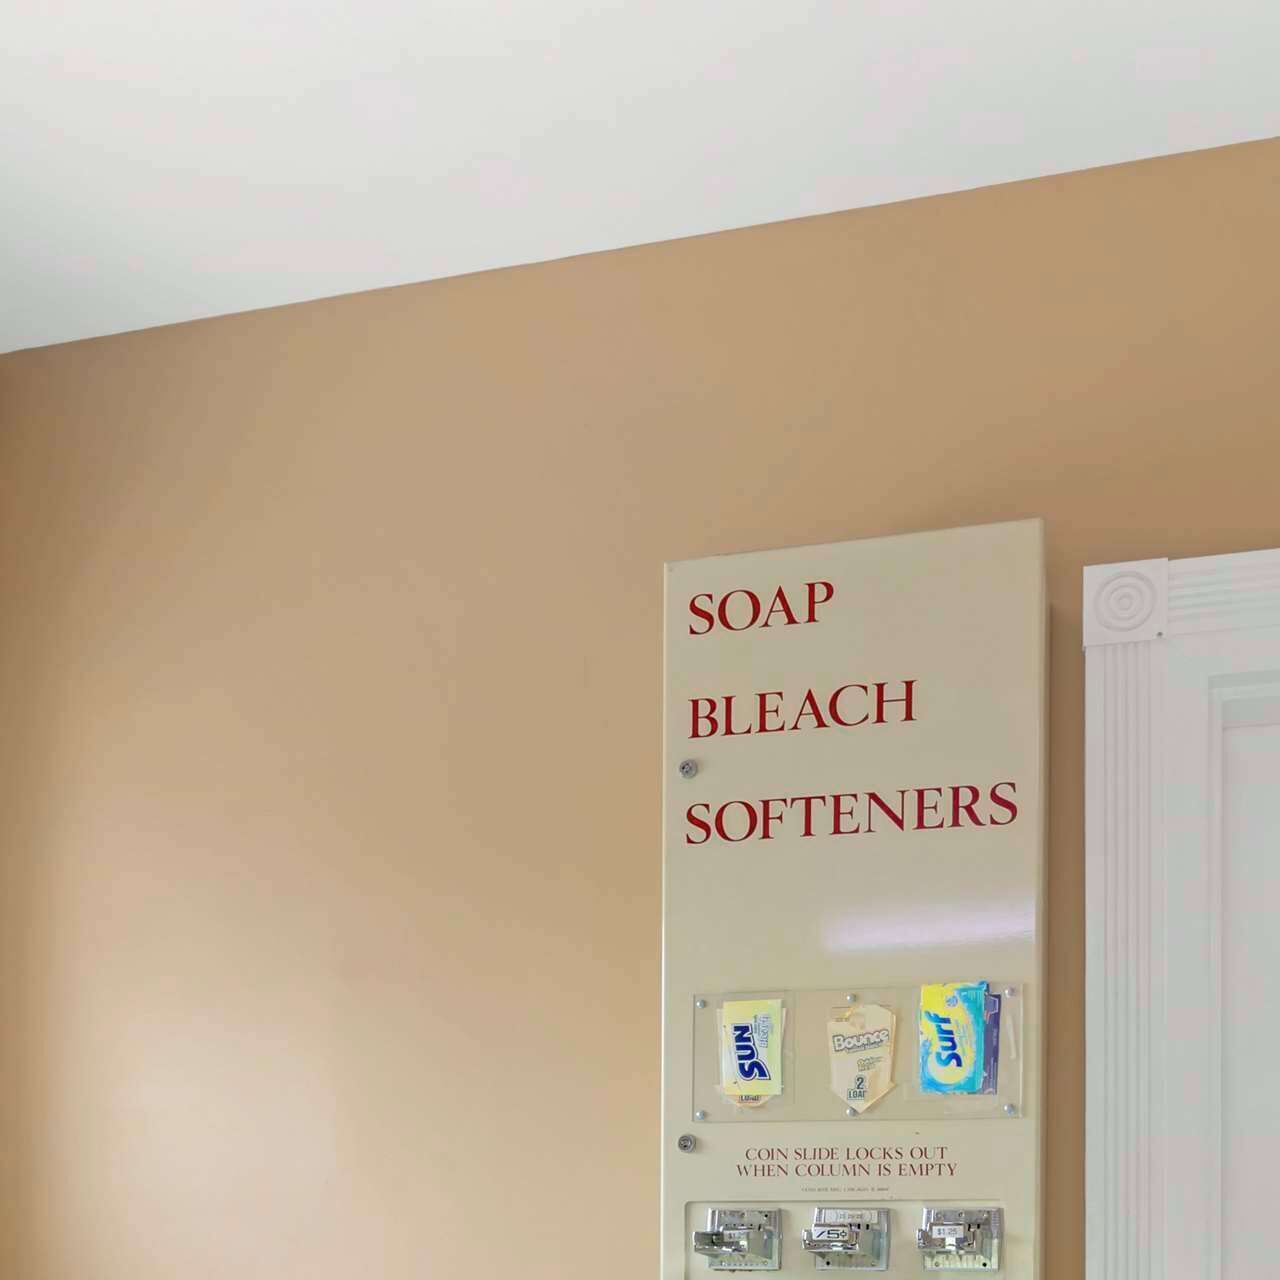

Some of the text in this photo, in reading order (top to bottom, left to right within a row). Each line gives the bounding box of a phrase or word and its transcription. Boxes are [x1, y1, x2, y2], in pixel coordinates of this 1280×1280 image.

[688, 580, 835, 636] SOAP
[687, 679, 919, 739] BLEACH
[685, 781, 1018, 845] SOFTENERS
[732, 1024, 770, 1079] SUN
[832, 1029, 889, 1052] Bounce
[924, 1010, 962, 1068] Surf
[856, 1077, 865, 1090] 2
[736, 1162, 958, 1177] WHEN COLUMN IS EMPTY
[745, 1146, 948, 1161] COIN SLIDE LOCKS OUT
